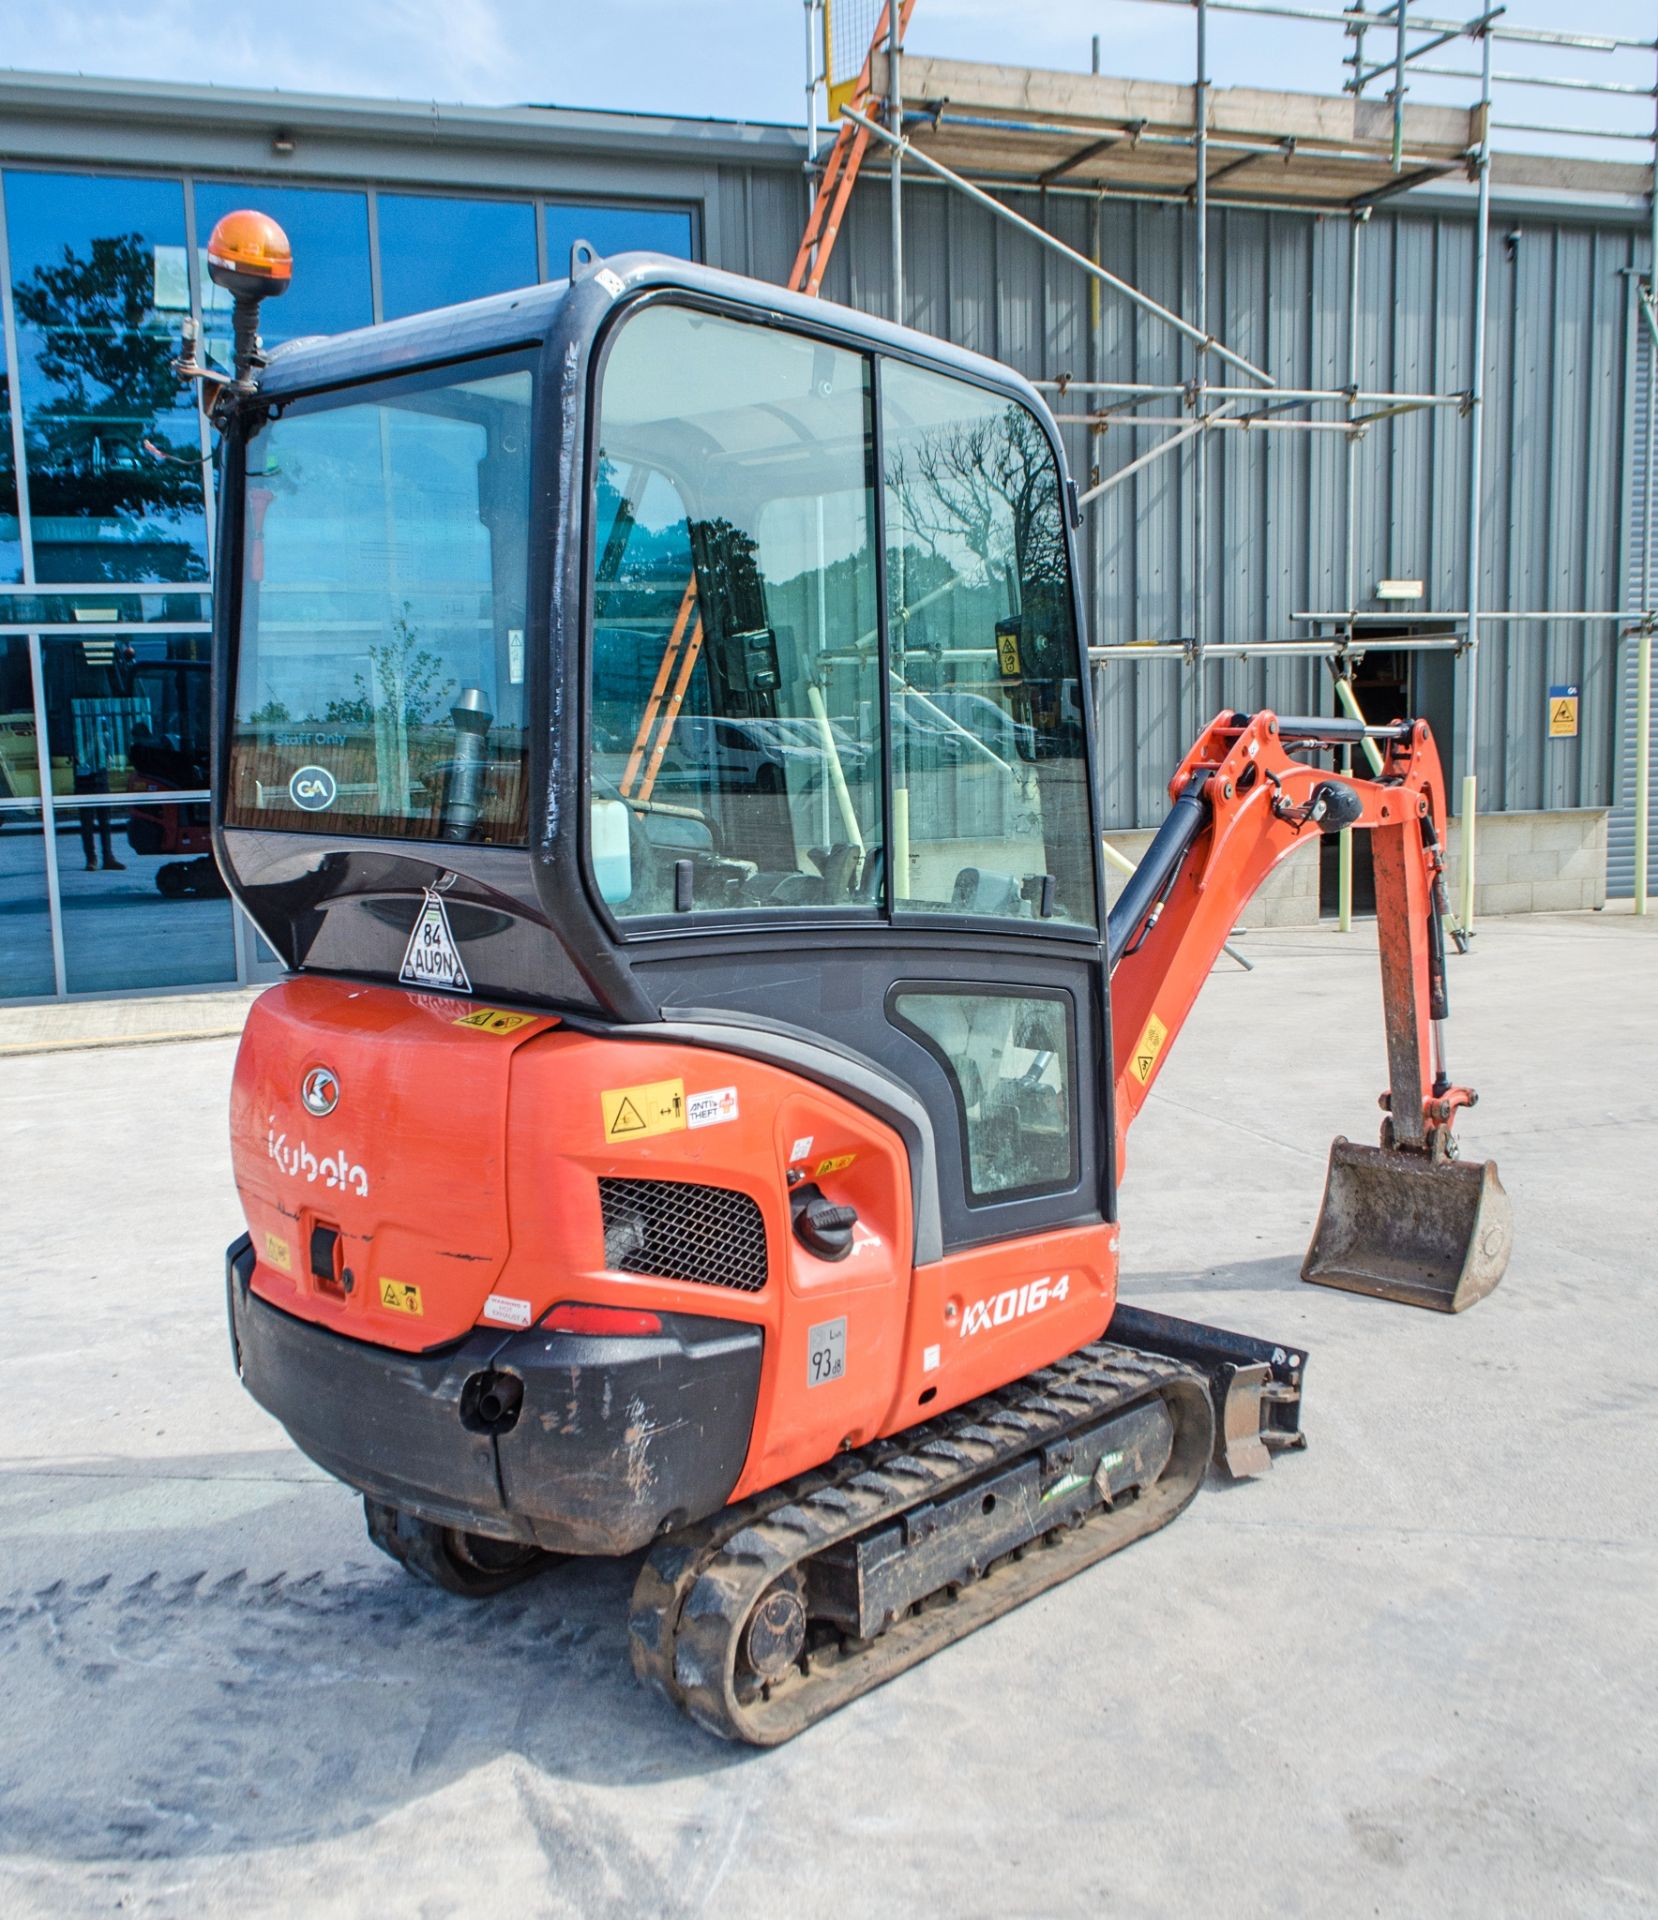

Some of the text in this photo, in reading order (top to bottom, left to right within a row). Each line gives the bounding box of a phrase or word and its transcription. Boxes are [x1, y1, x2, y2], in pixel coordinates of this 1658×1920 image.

[274, 732, 347, 747] Staff Only
[423, 923, 441, 948] 84
[416, 949, 453, 977] AU9N
[689, 1108, 718, 1120] THEFT
[268, 1115, 368, 1197] Kubota
[812, 1348, 832, 1380] 93
